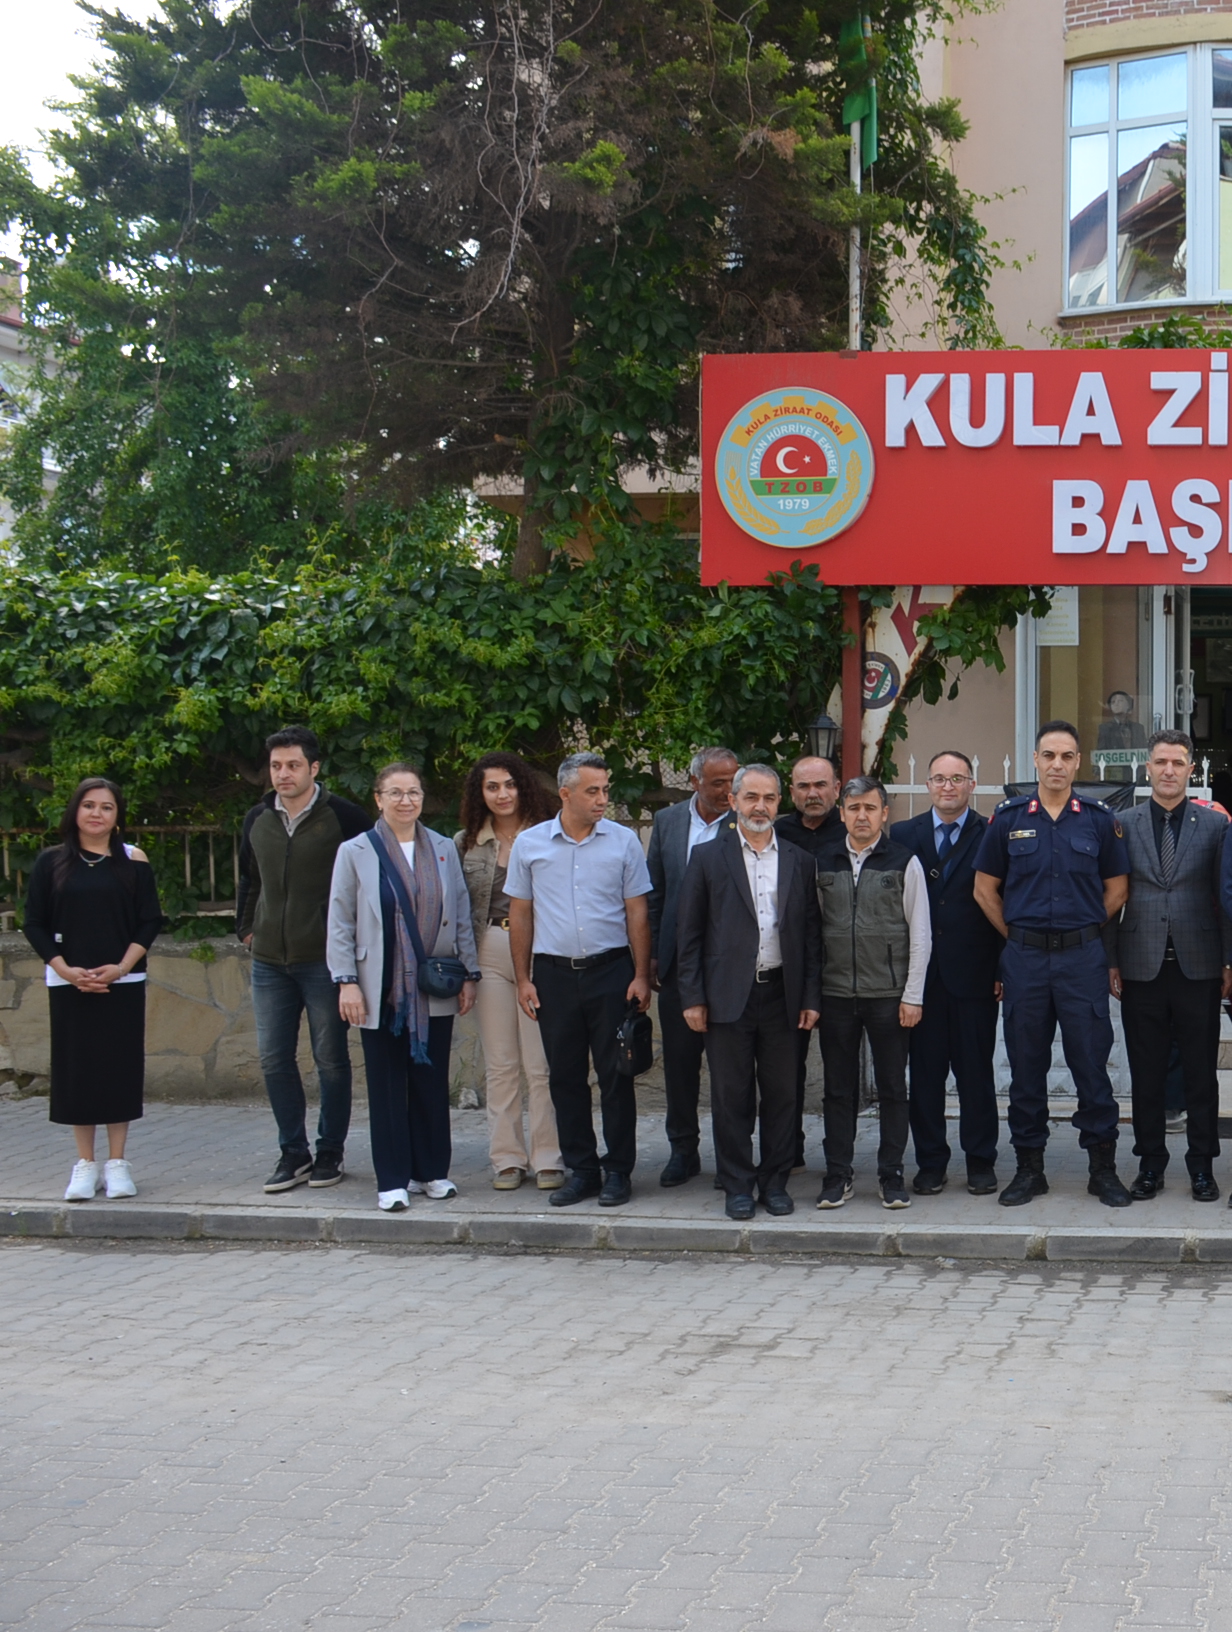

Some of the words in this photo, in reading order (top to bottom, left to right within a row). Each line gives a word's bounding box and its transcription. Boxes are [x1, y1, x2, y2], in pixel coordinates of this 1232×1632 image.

[744, 413, 771, 437] KULA
[772, 405, 812, 418] ZİRAAT
[814, 412, 843, 437] ODASI
[885, 373, 1122, 447] KULA
[750, 439, 768, 476] VATAN
[766, 422, 820, 442] HÜRRİYET
[817, 436, 838, 474] EKMEK
[765, 481, 824, 494] TZOB
[777, 498, 810, 510] 1979
